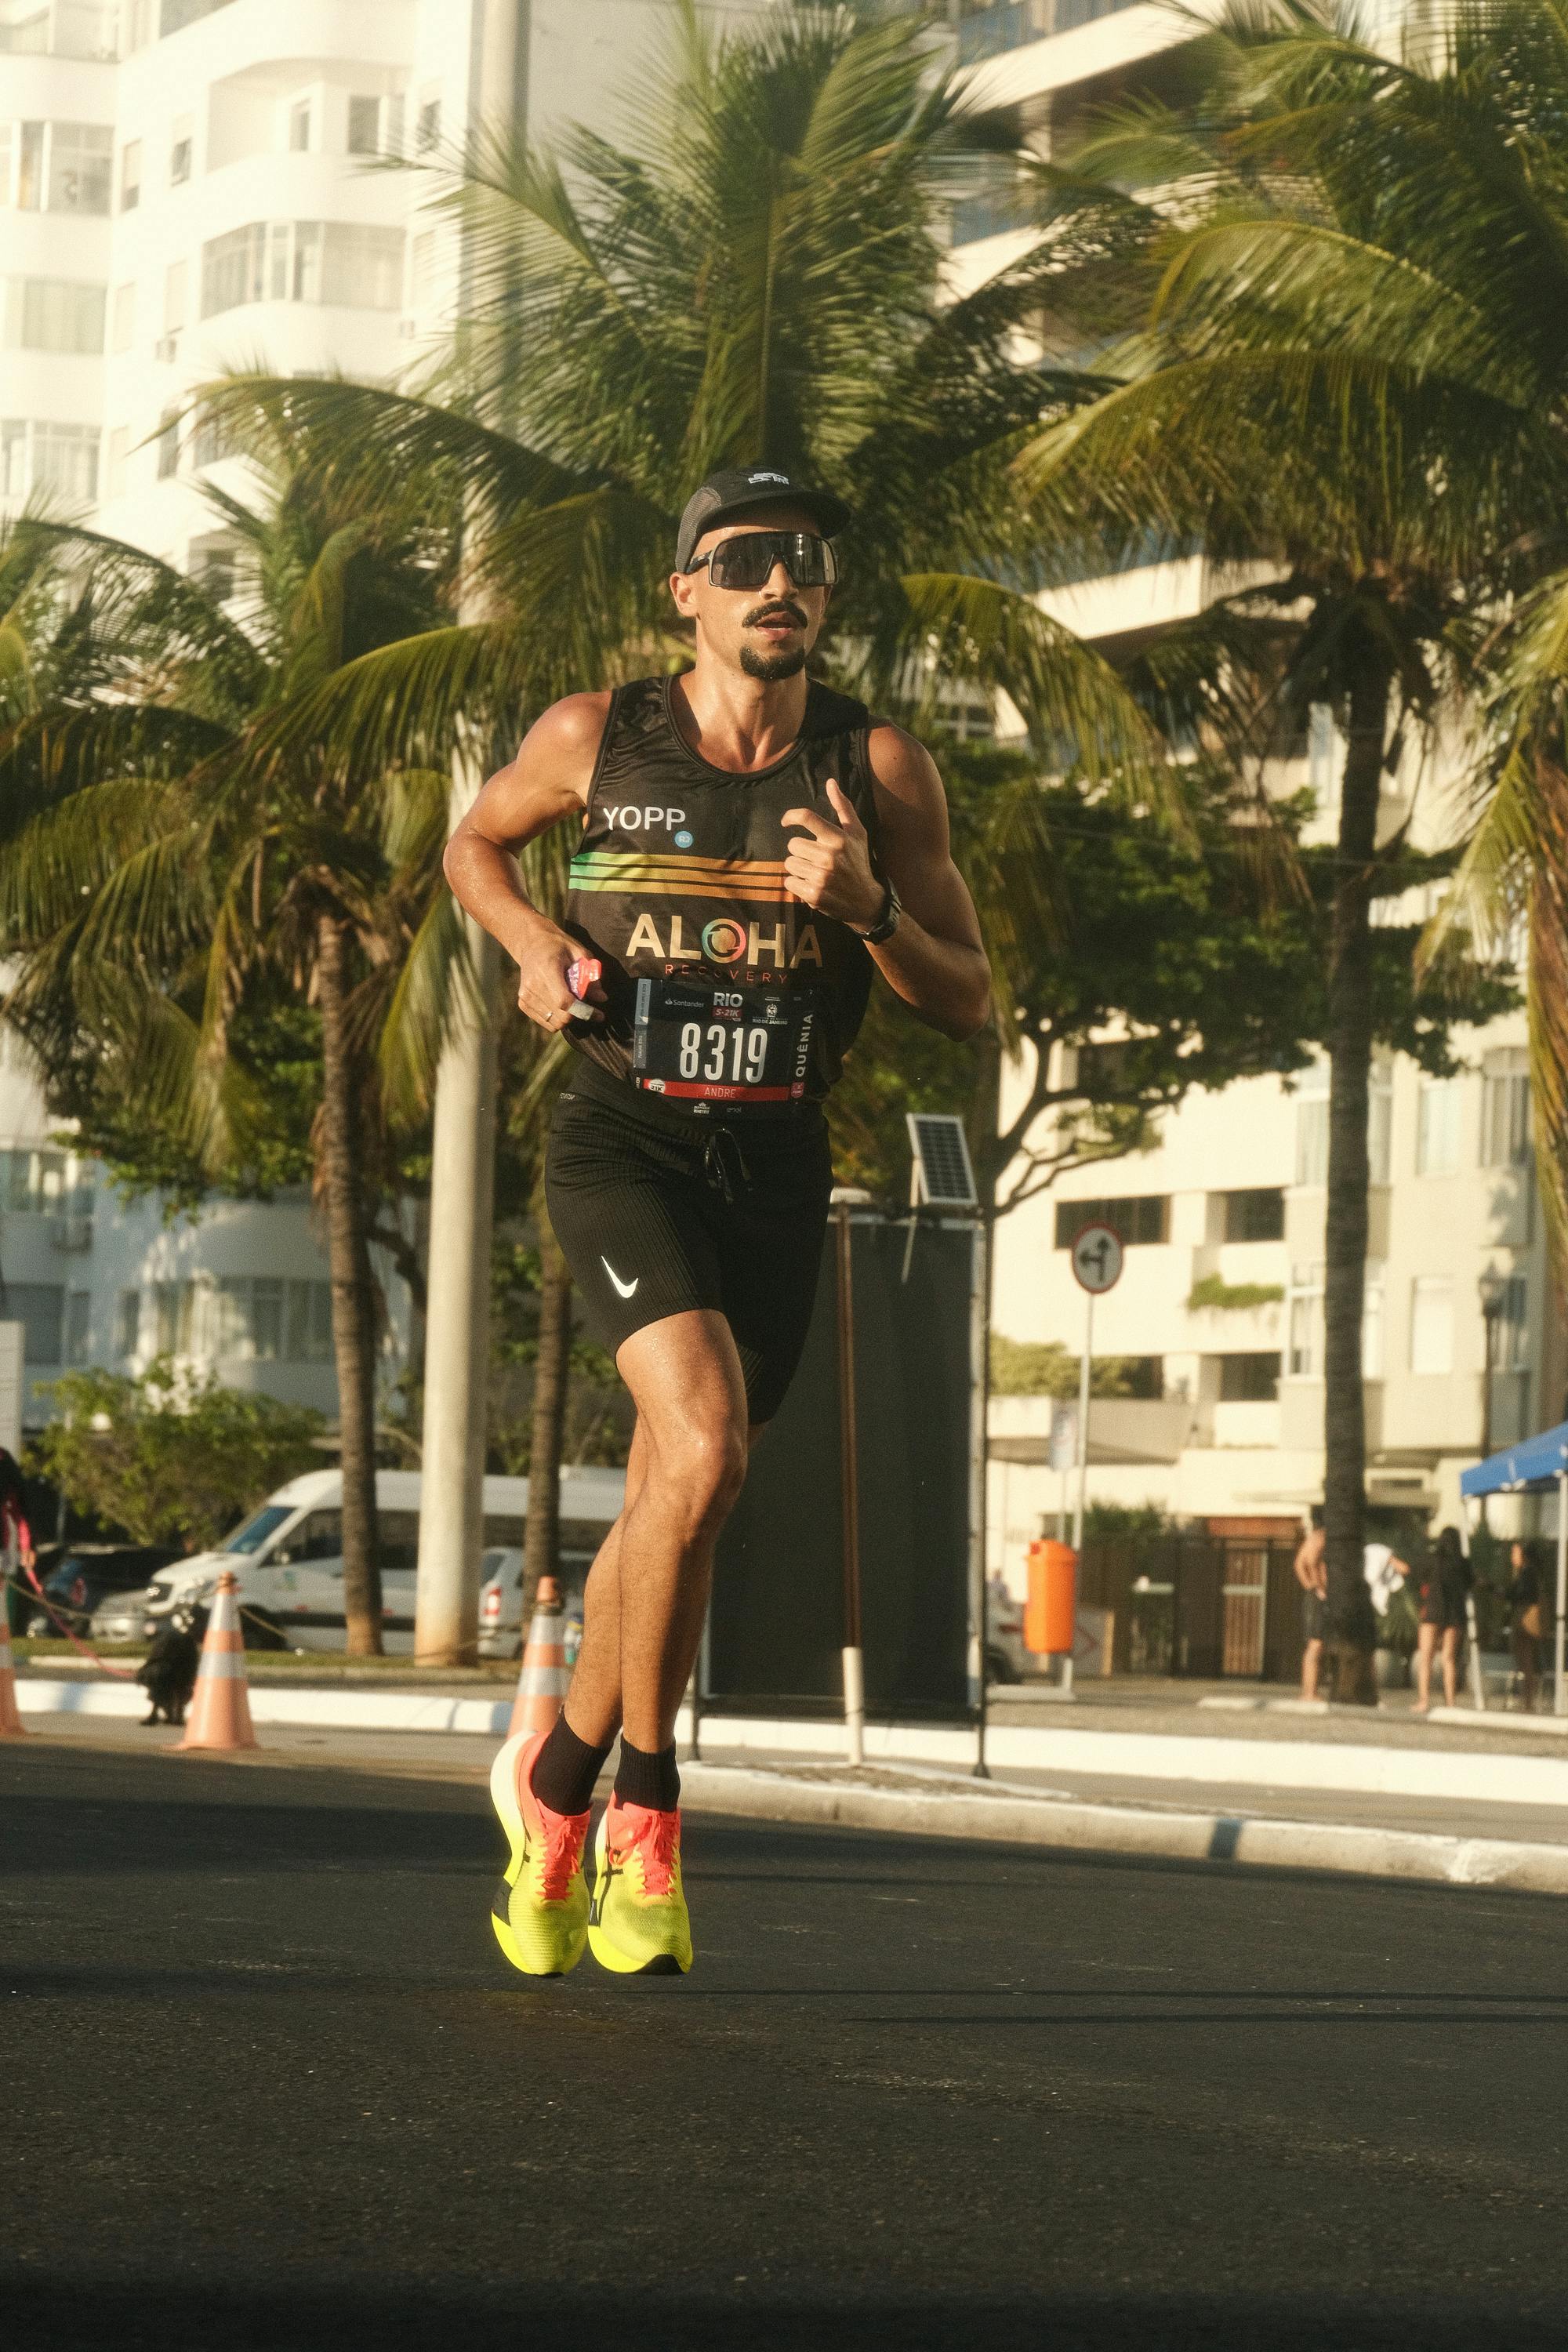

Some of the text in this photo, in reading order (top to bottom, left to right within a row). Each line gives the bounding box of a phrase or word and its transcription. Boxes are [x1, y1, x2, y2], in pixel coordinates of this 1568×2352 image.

[603, 805, 686, 831] YOPP
[626, 913, 823, 969] ALOHA
[664, 964, 788, 985] RECOVERY
[673, 999, 705, 1008] Santander
[713, 992, 743, 1007] RIO
[679, 1022, 768, 1083] 8319
[795, 1014, 814, 1077] QUÊNIA
[705, 1087, 737, 1098] ANDRE
